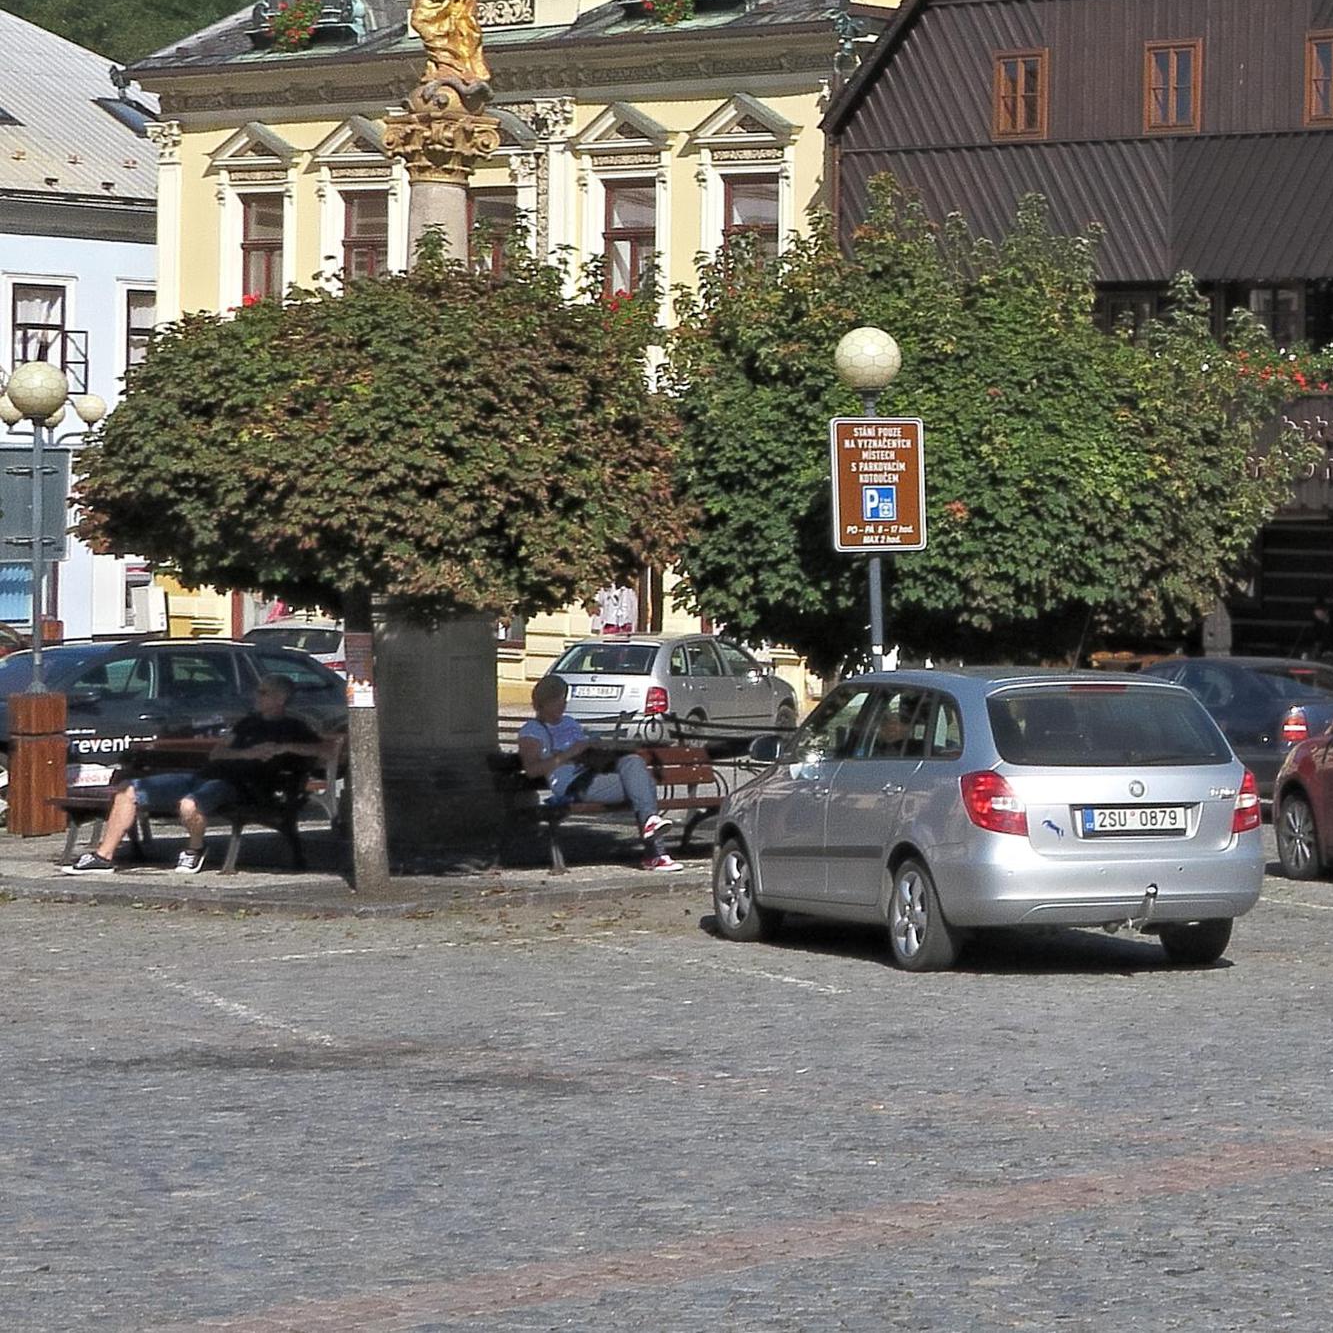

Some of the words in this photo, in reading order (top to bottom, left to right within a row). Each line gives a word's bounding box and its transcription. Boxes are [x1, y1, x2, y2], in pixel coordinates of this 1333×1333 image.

[853, 425, 876, 437] STÁNÍ
[878, 427, 902, 437] POUZE
[844, 439, 856, 449] NA
[862, 450, 895, 460] MÍSTECH
[851, 462, 857, 472] S
[859, 461, 906, 472] PARKOVACÍM
[859, 473, 900, 483] KOTOUČEM
[866, 489, 879, 517] P
[1098, 810, 1128, 828] 2SU
[1139, 809, 1178, 827] 0879
